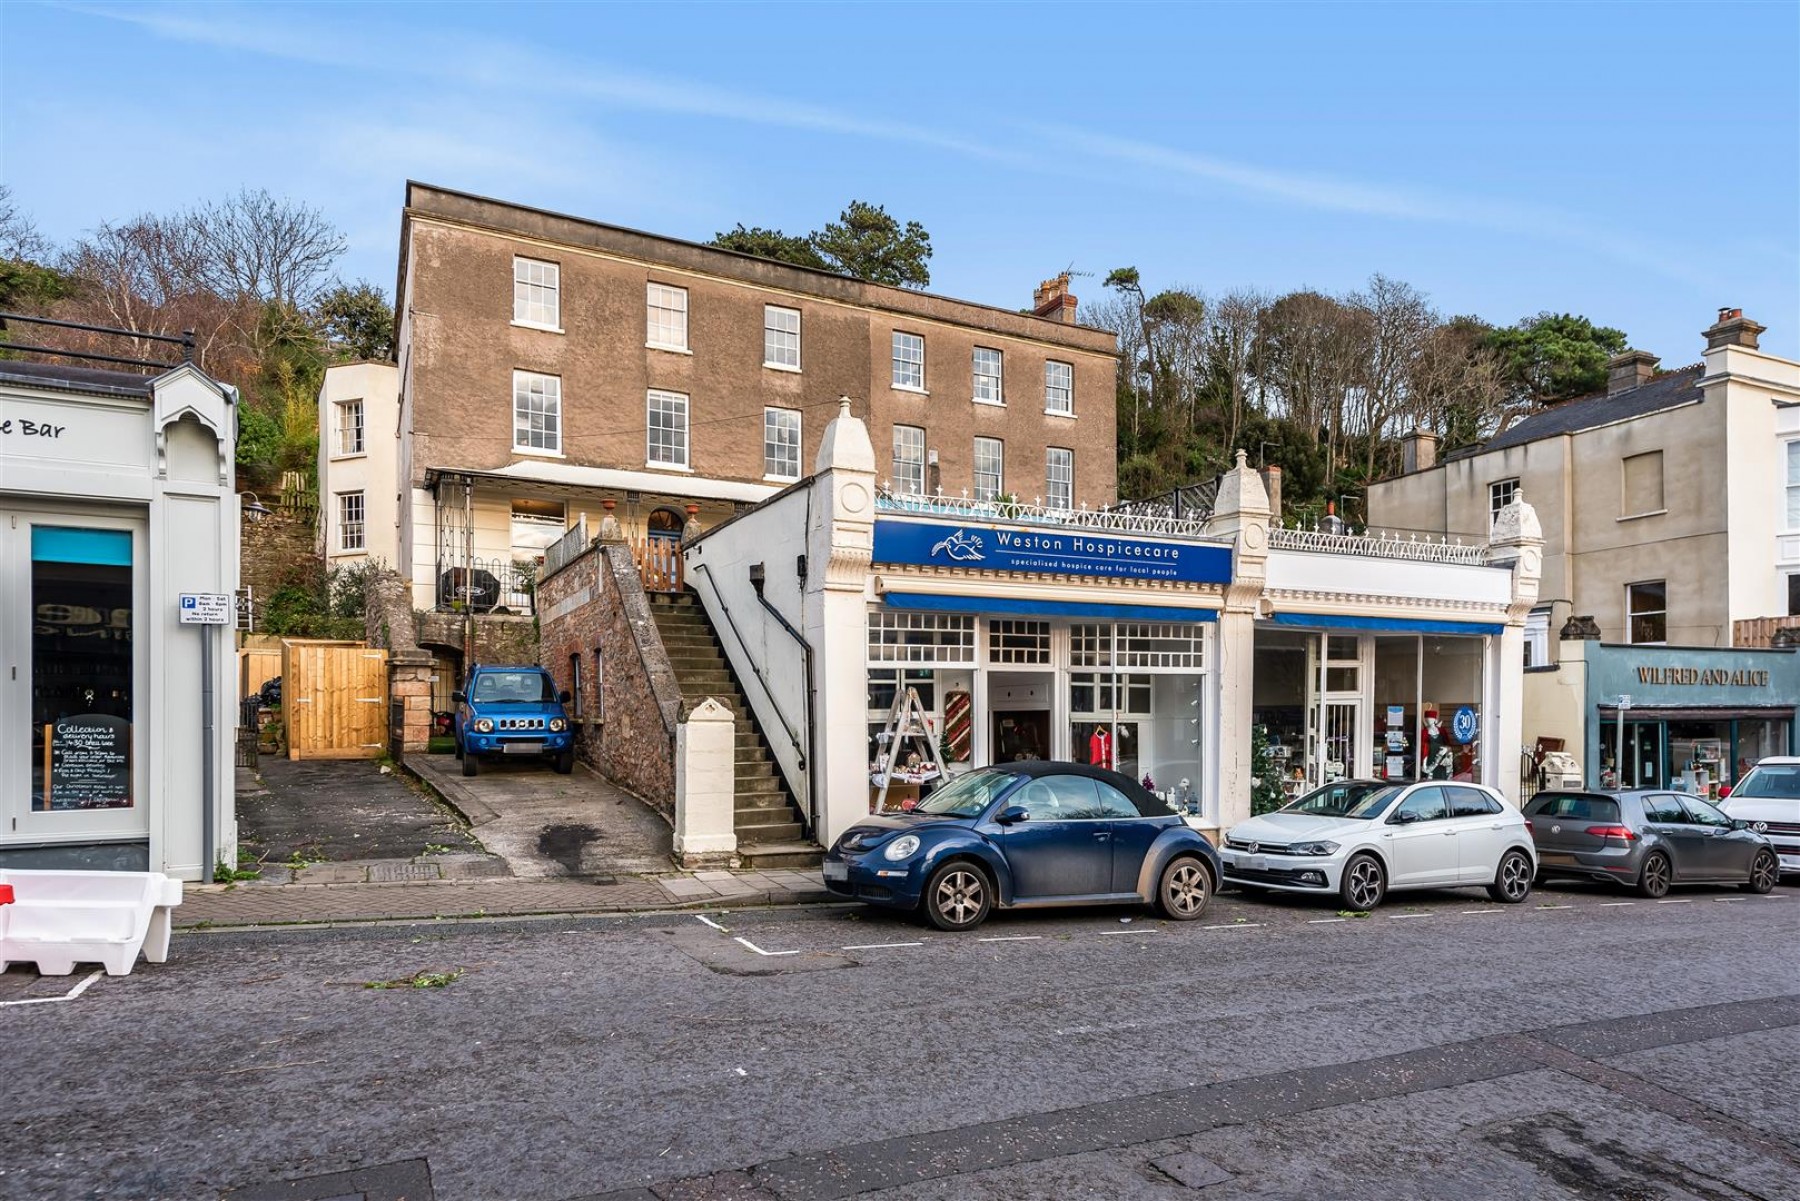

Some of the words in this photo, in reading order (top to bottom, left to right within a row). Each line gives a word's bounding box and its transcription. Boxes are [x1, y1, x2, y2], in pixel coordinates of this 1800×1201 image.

[19, 419, 66, 438] Bar
[997, 531, 1062, 549] Weston
[1073, 537, 1179, 559] Hospicecare
[1011, 559, 1058, 568] specialised
[1061, 561, 1092, 570] hospice
[1095, 564, 1112, 572] care
[1115, 564, 1127, 573] for
[1130, 565, 1149, 574] local
[1152, 568, 1177, 576] people
[1637, 666, 1698, 685] WILFRED
[1700, 668, 1730, 686] AND
[1730, 669, 1769, 687] ALICE
[57, 723, 108, 734] Collection
[1459, 714, 1471, 729] 30
